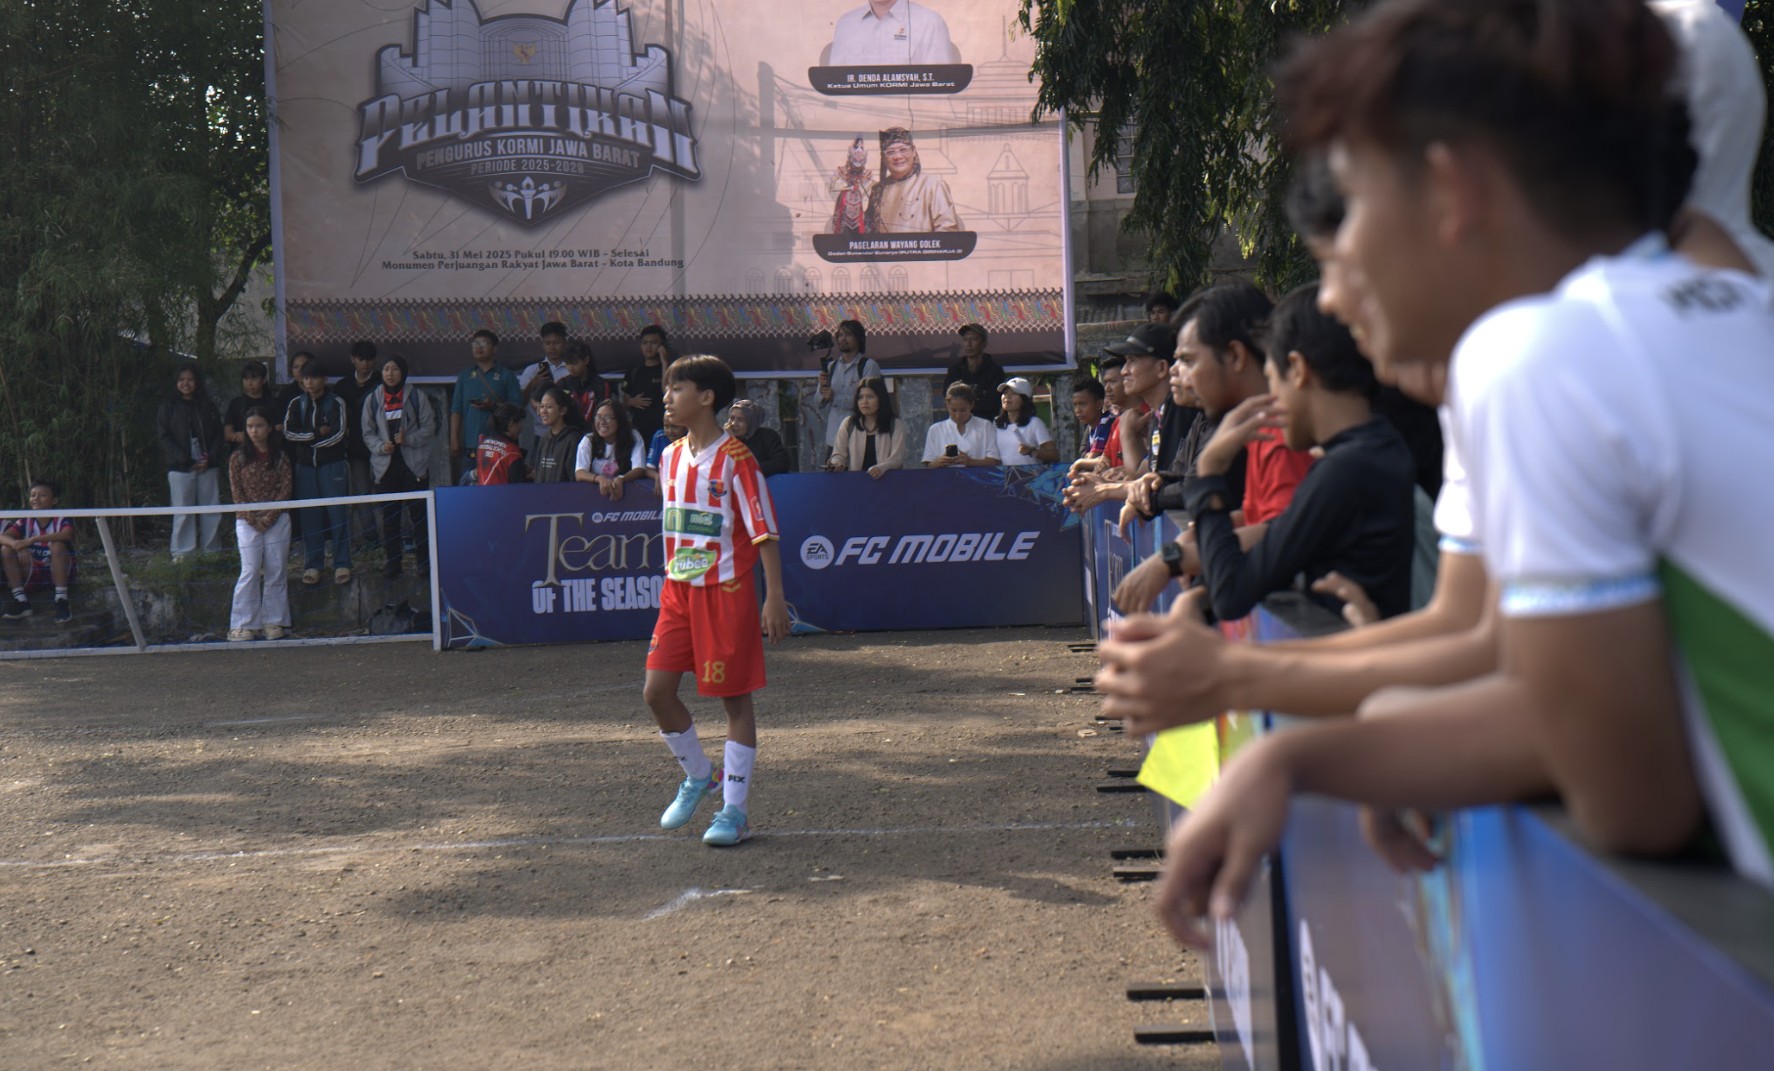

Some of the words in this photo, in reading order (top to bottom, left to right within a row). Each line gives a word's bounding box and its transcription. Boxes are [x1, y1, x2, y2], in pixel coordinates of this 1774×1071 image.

[858, 74, 880, 82] DENDA
[882, 73, 921, 83] ALAMSYAH,
[922, 73, 935, 81] S.T.
[356, 79, 699, 177] PELANTIKAN
[416, 140, 493, 170] PENGURUS
[497, 137, 544, 155] KORMI
[549, 139, 588, 158] JAWA
[592, 143, 641, 168] BARAT
[470, 159, 517, 175] PERIODE
[849, 241, 888, 250] PAGELARAN
[890, 241, 917, 249] WAYANG
[919, 240, 941, 248] GOLEK
[413, 250, 447, 260] Sabtu,
[449, 250, 459, 259] 31
[463, 250, 483, 259] Mei
[486, 250, 511, 259] 2025
[514, 250, 545, 259] Pukul
[549, 249, 575, 259] 19.00
[578, 249, 600, 258] WIB
[611, 248, 649, 258] Selesai
[382, 261, 435, 270] Monumen
[438, 260, 498, 271] Perjuangan
[501, 260, 539, 271] Rakyat
[542, 259, 567, 270] Jawa
[570, 259, 599, 268] Barat
[610, 258, 634, 268] Kota
[637, 258, 684, 269] Bandung
[603, 512, 621, 522] FC
[807, 543, 828, 554] EA
[834, 535, 891, 566] FC
[887, 530, 1041, 564] MOBILE
[561, 578, 597, 612] THE
[601, 575, 666, 611] SEASO
[702, 660, 725, 684] 18
